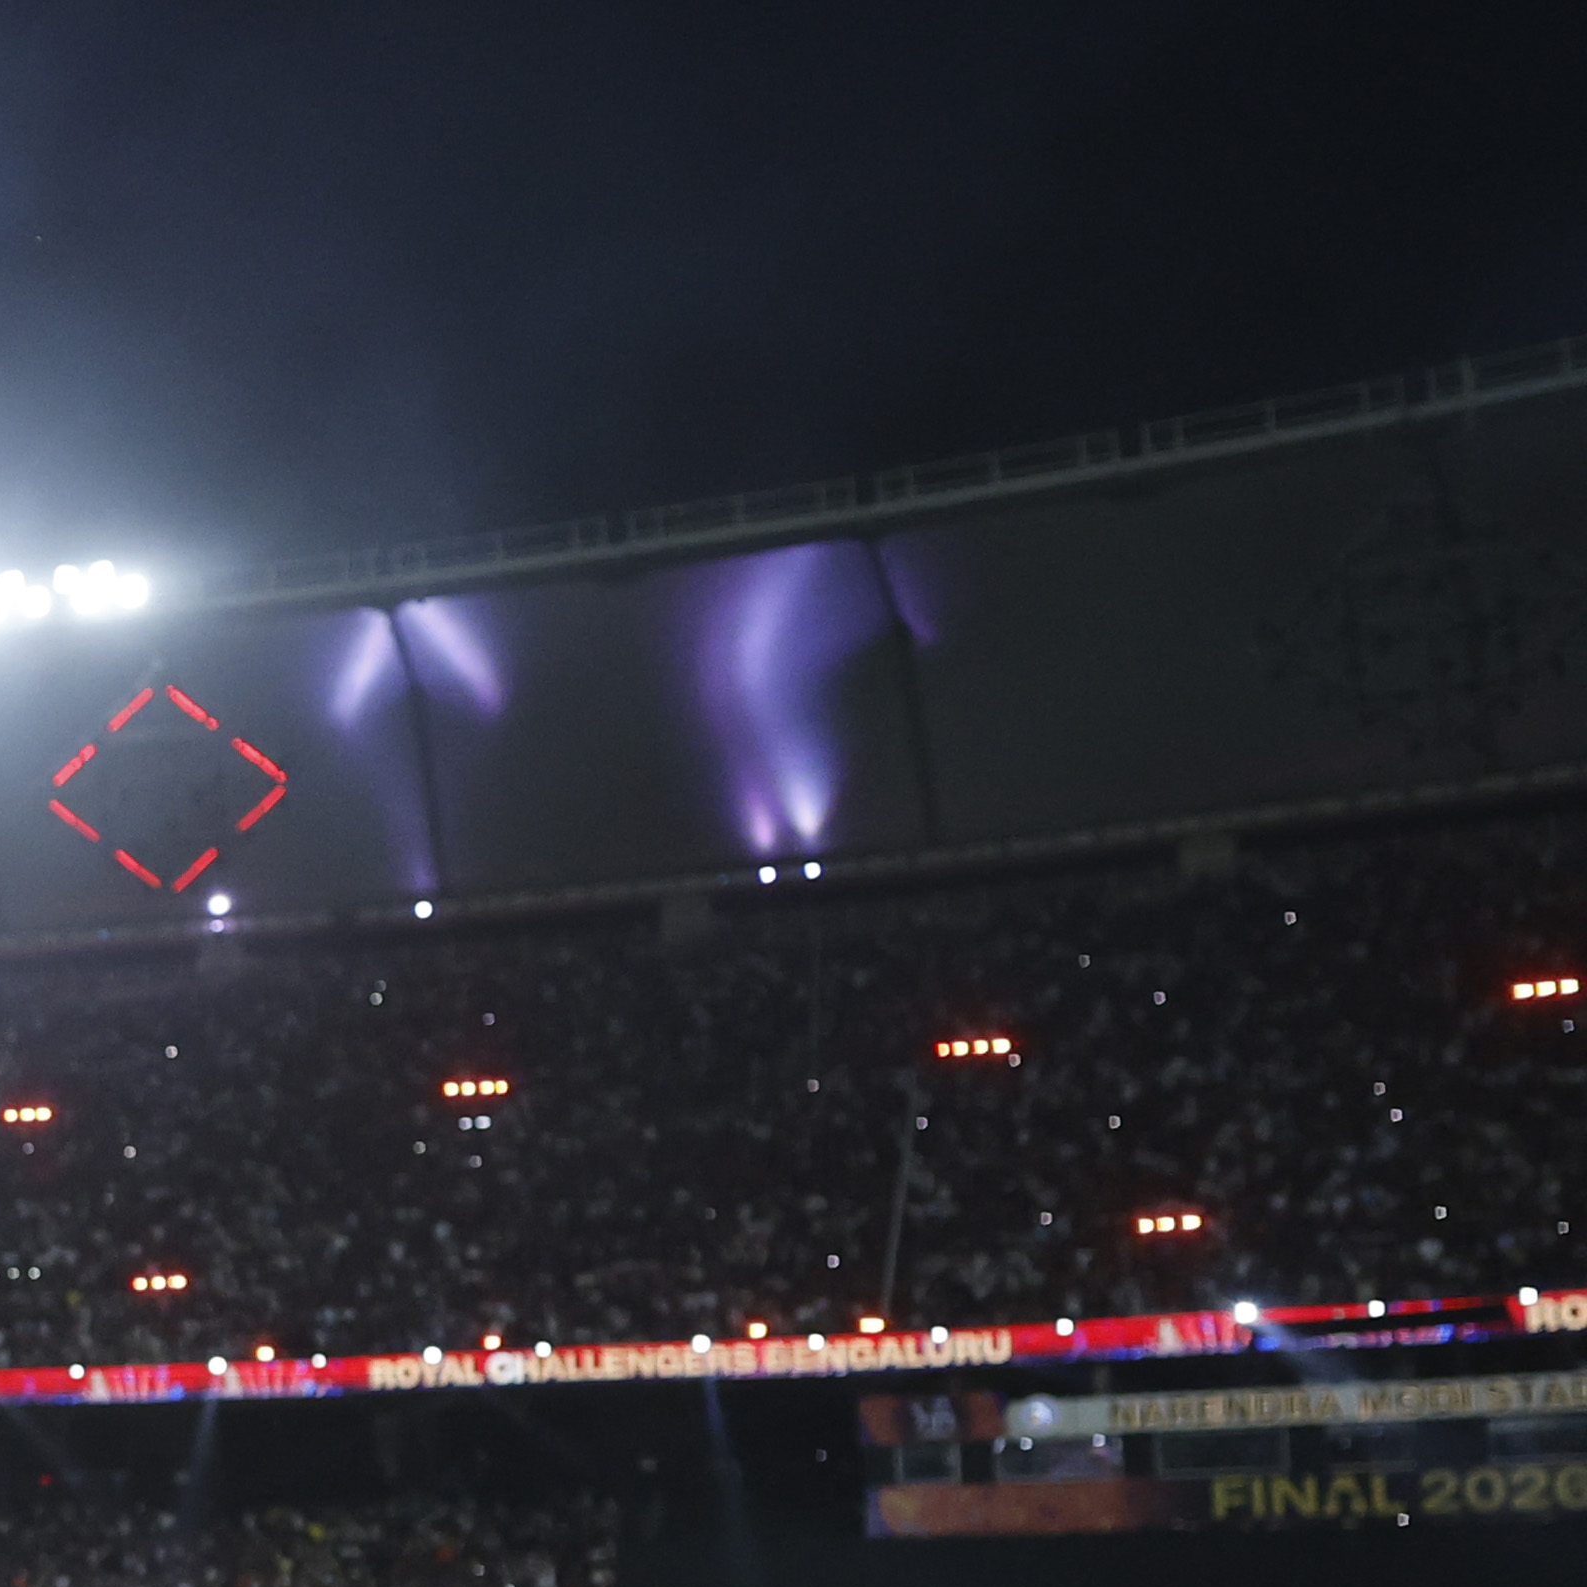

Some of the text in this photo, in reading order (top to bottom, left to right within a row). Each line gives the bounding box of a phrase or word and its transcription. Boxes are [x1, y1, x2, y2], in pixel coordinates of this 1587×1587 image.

[368, 1353, 484, 1391] ROYAL
[484, 1342, 758, 1385] CHALLENGERS
[1211, 1472, 1405, 1520] FINAL
